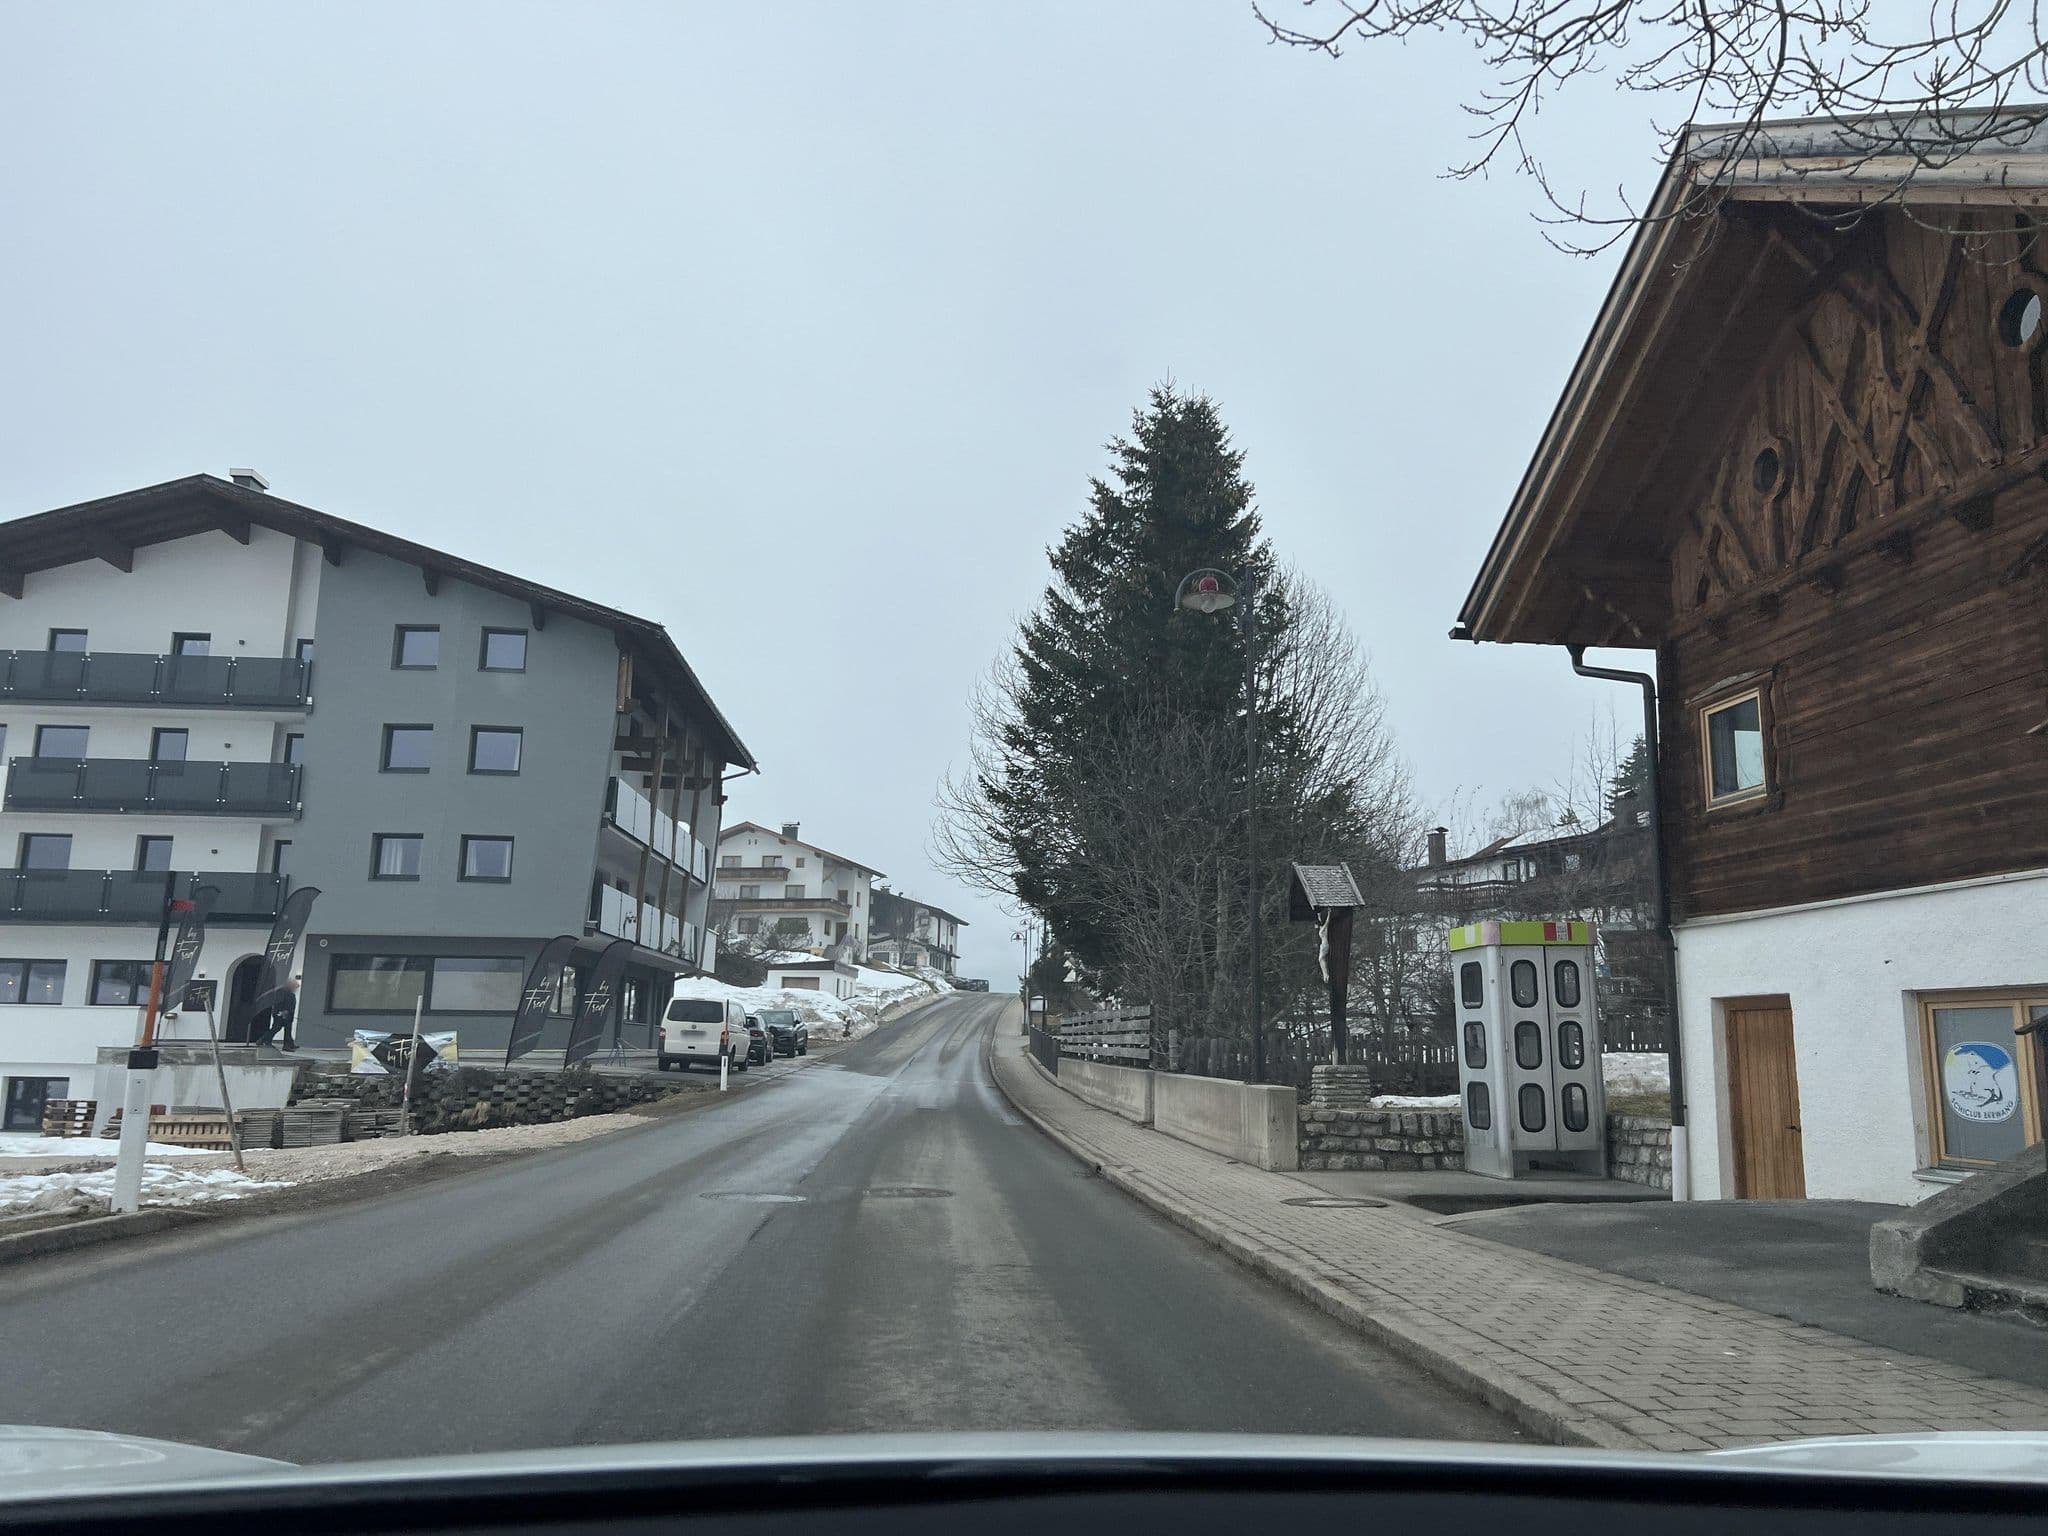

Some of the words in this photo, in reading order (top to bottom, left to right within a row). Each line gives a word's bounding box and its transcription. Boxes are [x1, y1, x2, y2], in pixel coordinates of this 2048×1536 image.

[283, 928, 294, 941] by
[269, 939, 294, 968] Fred
[540, 976, 550, 991] by
[599, 980, 609, 994] by
[525, 987, 551, 1015] Fred
[584, 992, 611, 1017] Fred
[389, 1038, 419, 1067] Fr
